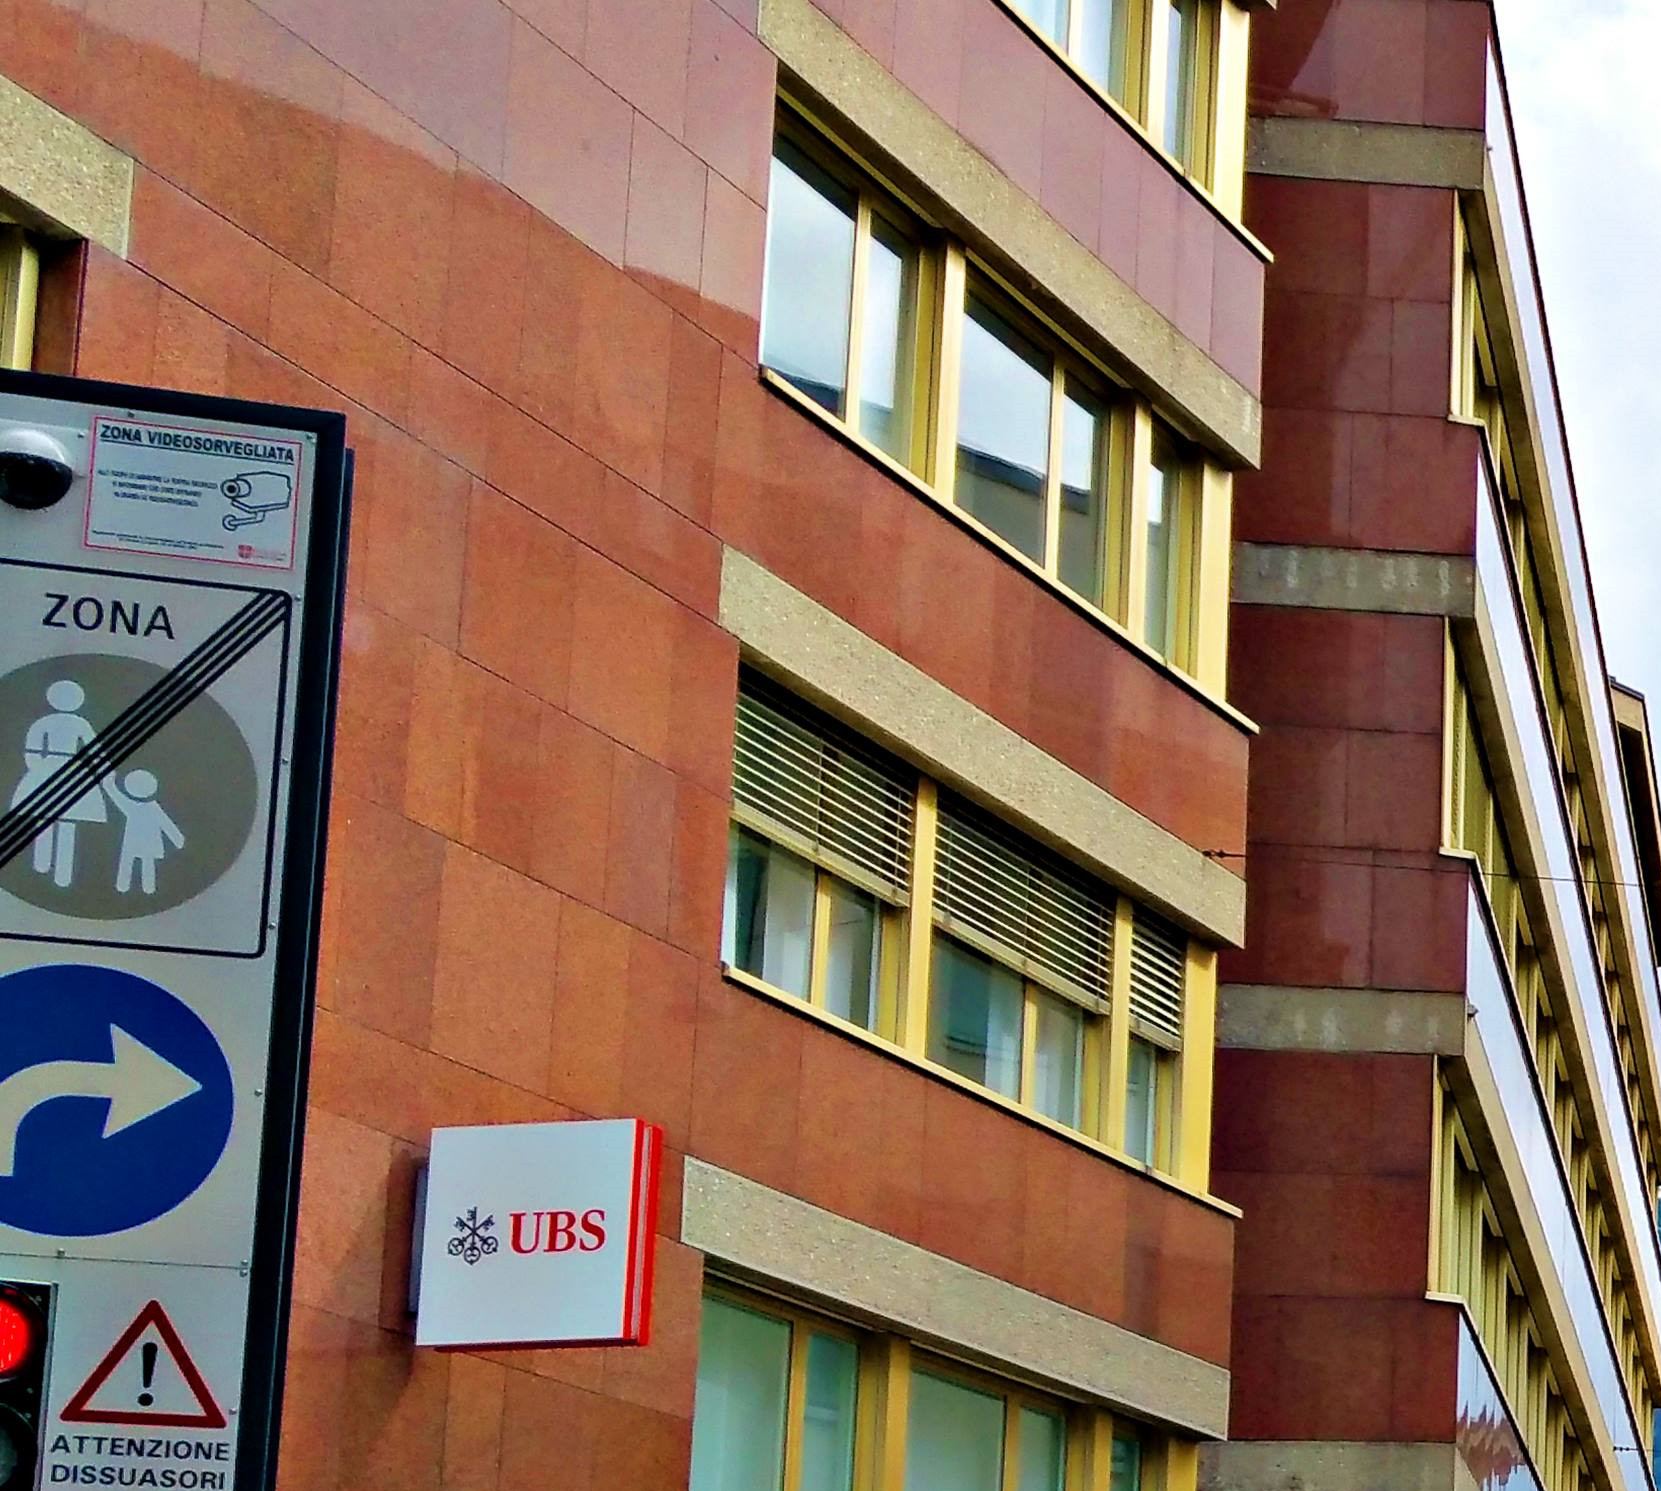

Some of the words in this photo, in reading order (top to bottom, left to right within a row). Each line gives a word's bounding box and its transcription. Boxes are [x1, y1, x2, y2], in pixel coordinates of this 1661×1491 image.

[101, 424, 142, 443] ZONA
[147, 430, 295, 462] VIDEOSORVEGLIATA
[42, 592, 176, 641] ZONA
[509, 1209, 607, 1254] UBS
[50, 1434, 231, 1463] ATTENZIONE
[50, 1463, 226, 1491] DISSUASORI
